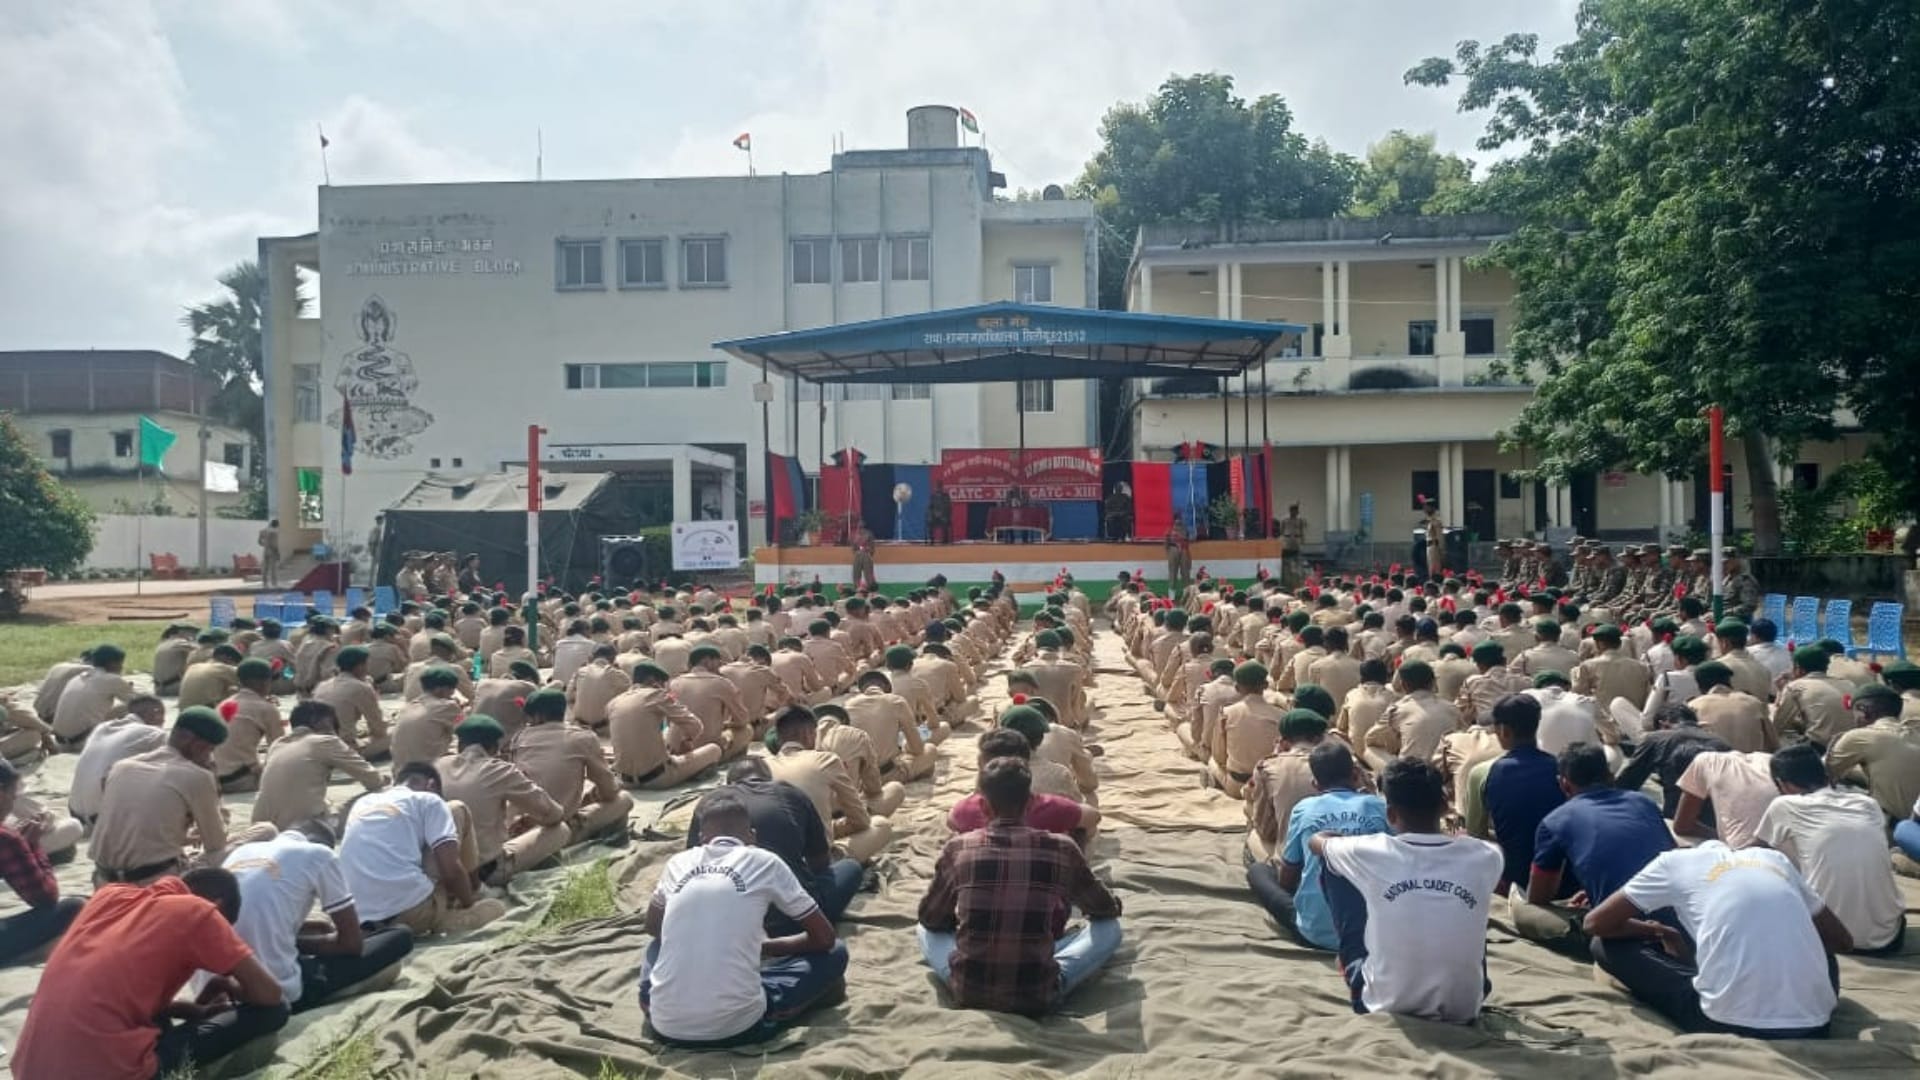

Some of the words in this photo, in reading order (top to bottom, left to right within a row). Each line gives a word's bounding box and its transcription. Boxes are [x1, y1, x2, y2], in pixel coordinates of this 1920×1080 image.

[469, 259, 521, 273] BLOCK
[948, 487, 983, 499] CATC
[1029, 487, 1064, 499] CATC
[1073, 486, 1096, 497] XIII
[1384, 879, 1423, 902] NATIONAL
[1423, 879, 1454, 893] CADET
[1454, 886, 1477, 909] CORPS
